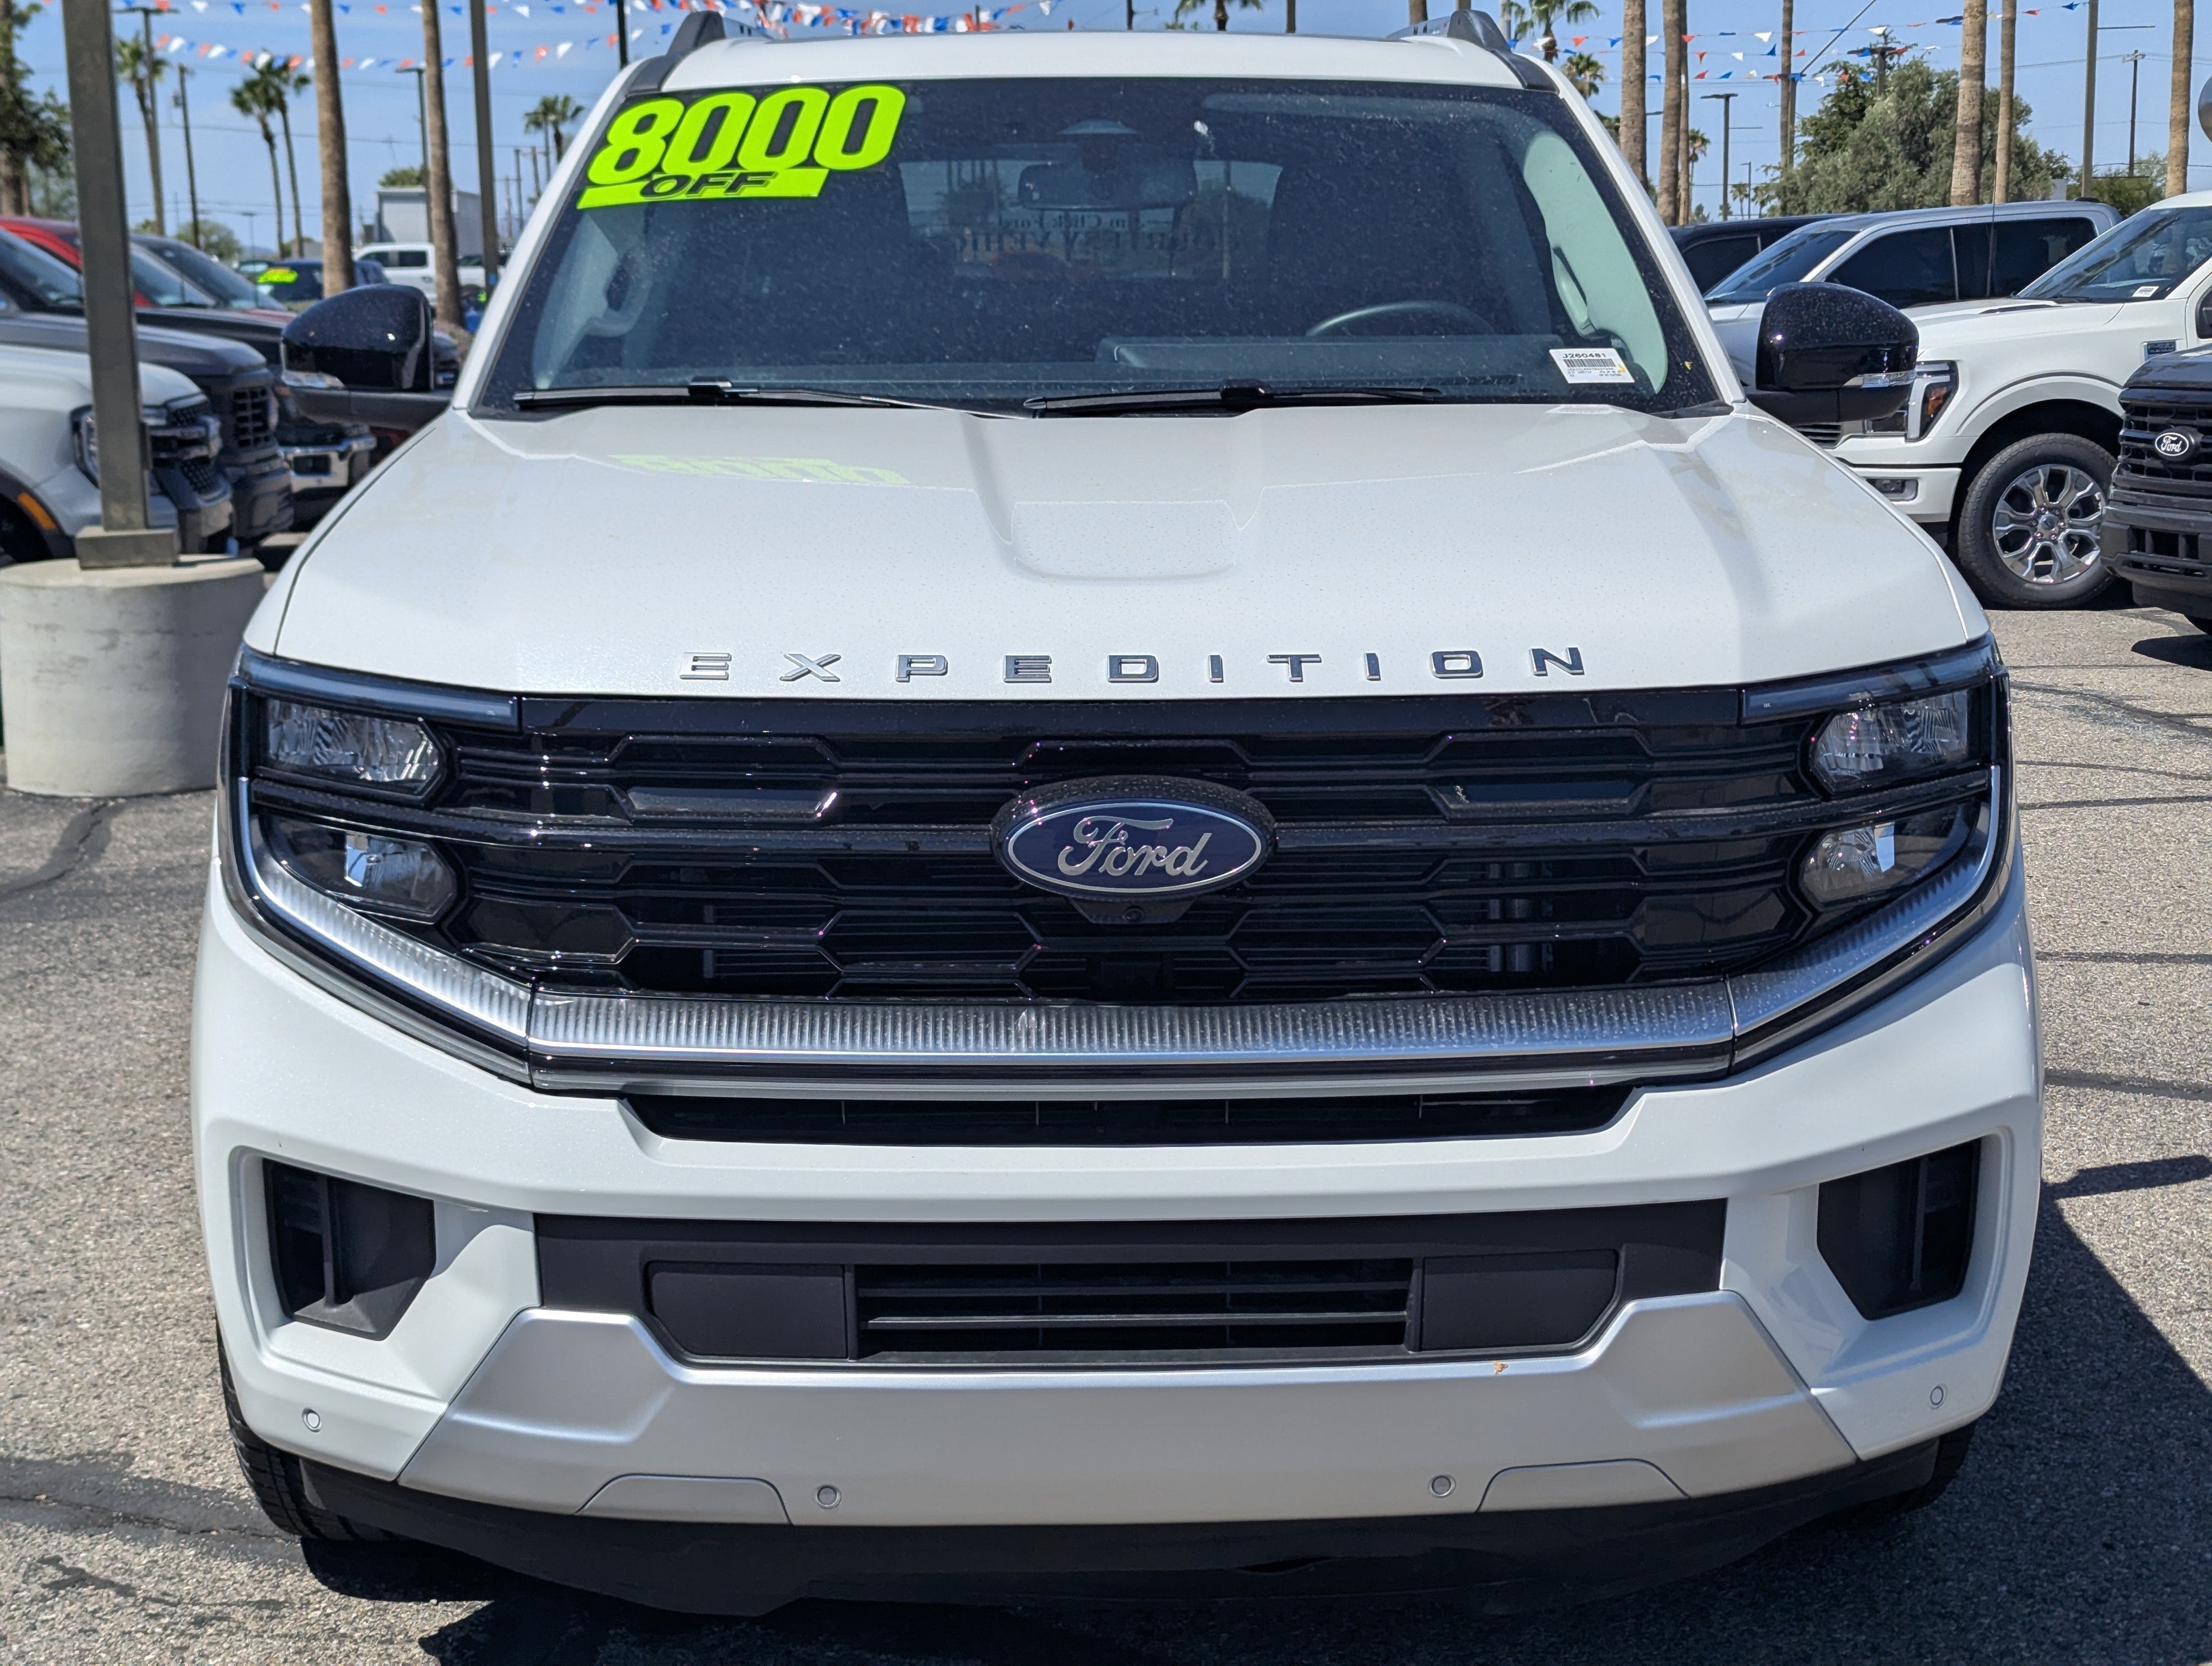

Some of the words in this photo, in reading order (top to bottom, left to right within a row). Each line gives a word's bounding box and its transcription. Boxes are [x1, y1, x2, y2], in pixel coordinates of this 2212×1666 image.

[587, 84, 906, 185] 8000
[640, 171, 777, 199] OFF
[2160, 435, 2183, 452] Ford
[679, 648, 1585, 683] EXPEDITION
[1058, 816, 1213, 876] Ford
